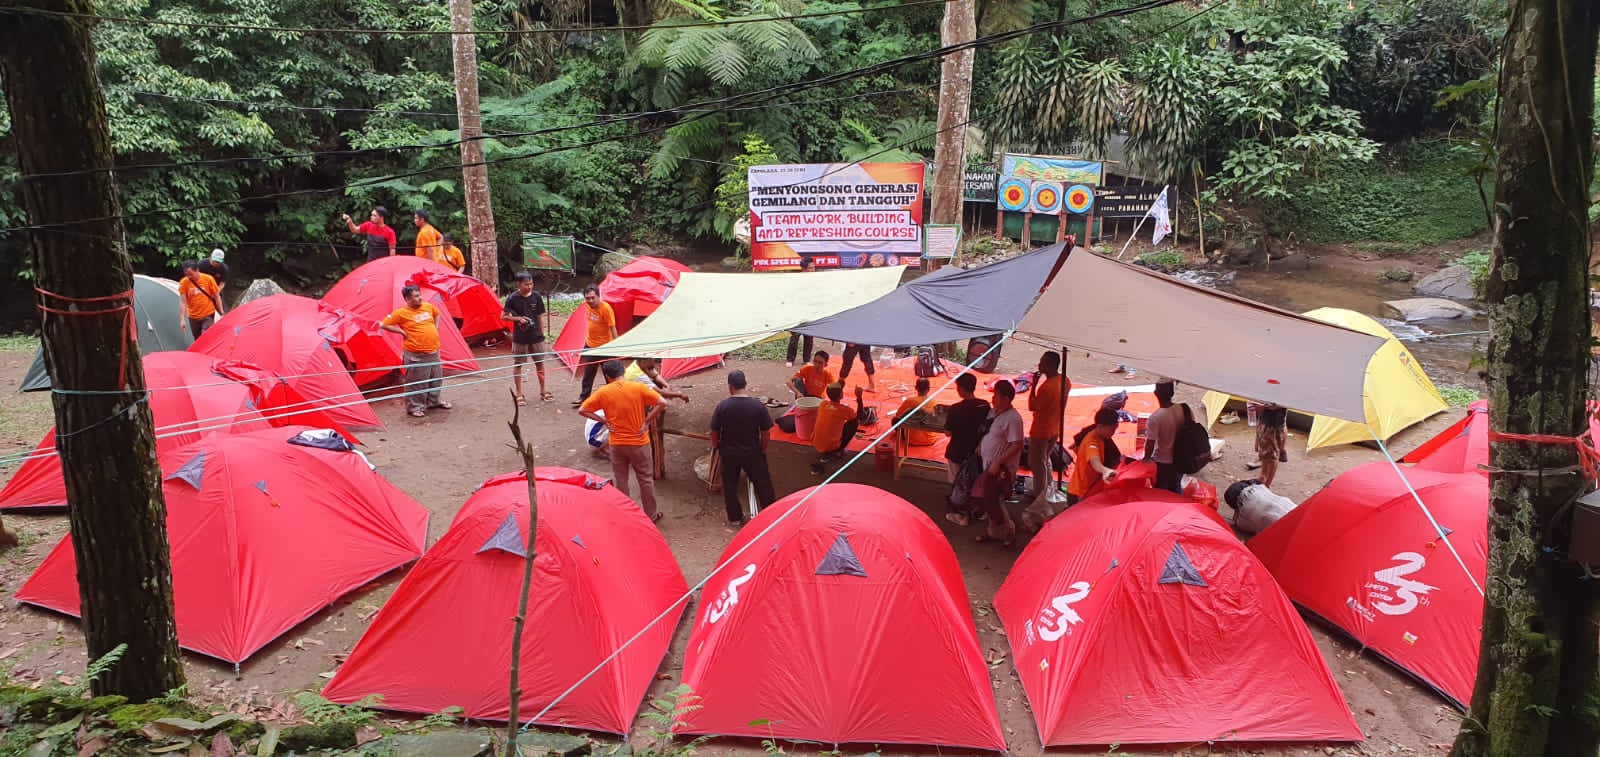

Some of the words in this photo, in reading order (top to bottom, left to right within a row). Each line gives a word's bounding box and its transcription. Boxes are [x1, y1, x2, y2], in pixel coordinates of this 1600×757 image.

[855, 184, 918, 194] GENERASI
[752, 196, 817, 207] GEMILANG
[819, 196, 846, 206] DAN
[848, 195, 916, 206] TANGGUH"
[767, 214, 801, 225] TEAM
[847, 213, 905, 224] BUILDING
[758, 228, 783, 239] AND
[785, 227, 862, 238] REFRESHING
[865, 227, 915, 238] COURSE
